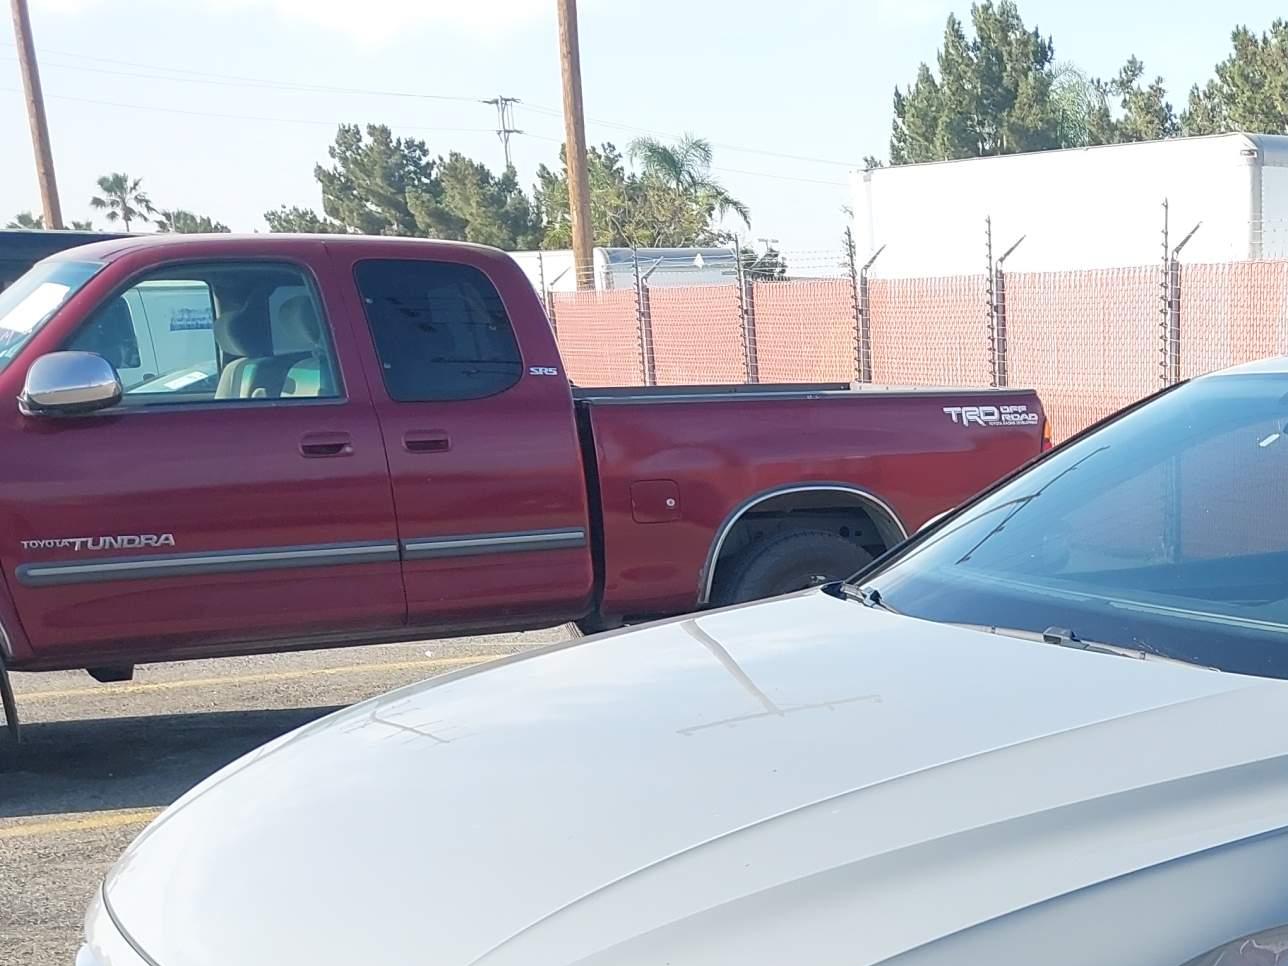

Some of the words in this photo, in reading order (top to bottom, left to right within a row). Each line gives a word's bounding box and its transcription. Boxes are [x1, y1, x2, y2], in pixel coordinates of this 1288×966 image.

[529, 367, 558, 376] SR5
[1000, 405, 1027, 413] OFF
[943, 406, 1000, 427] TRD
[1001, 413, 1039, 421] ROAD
[21, 539, 70, 549] TOYOTA
[69, 533, 175, 551] TUNDRA
